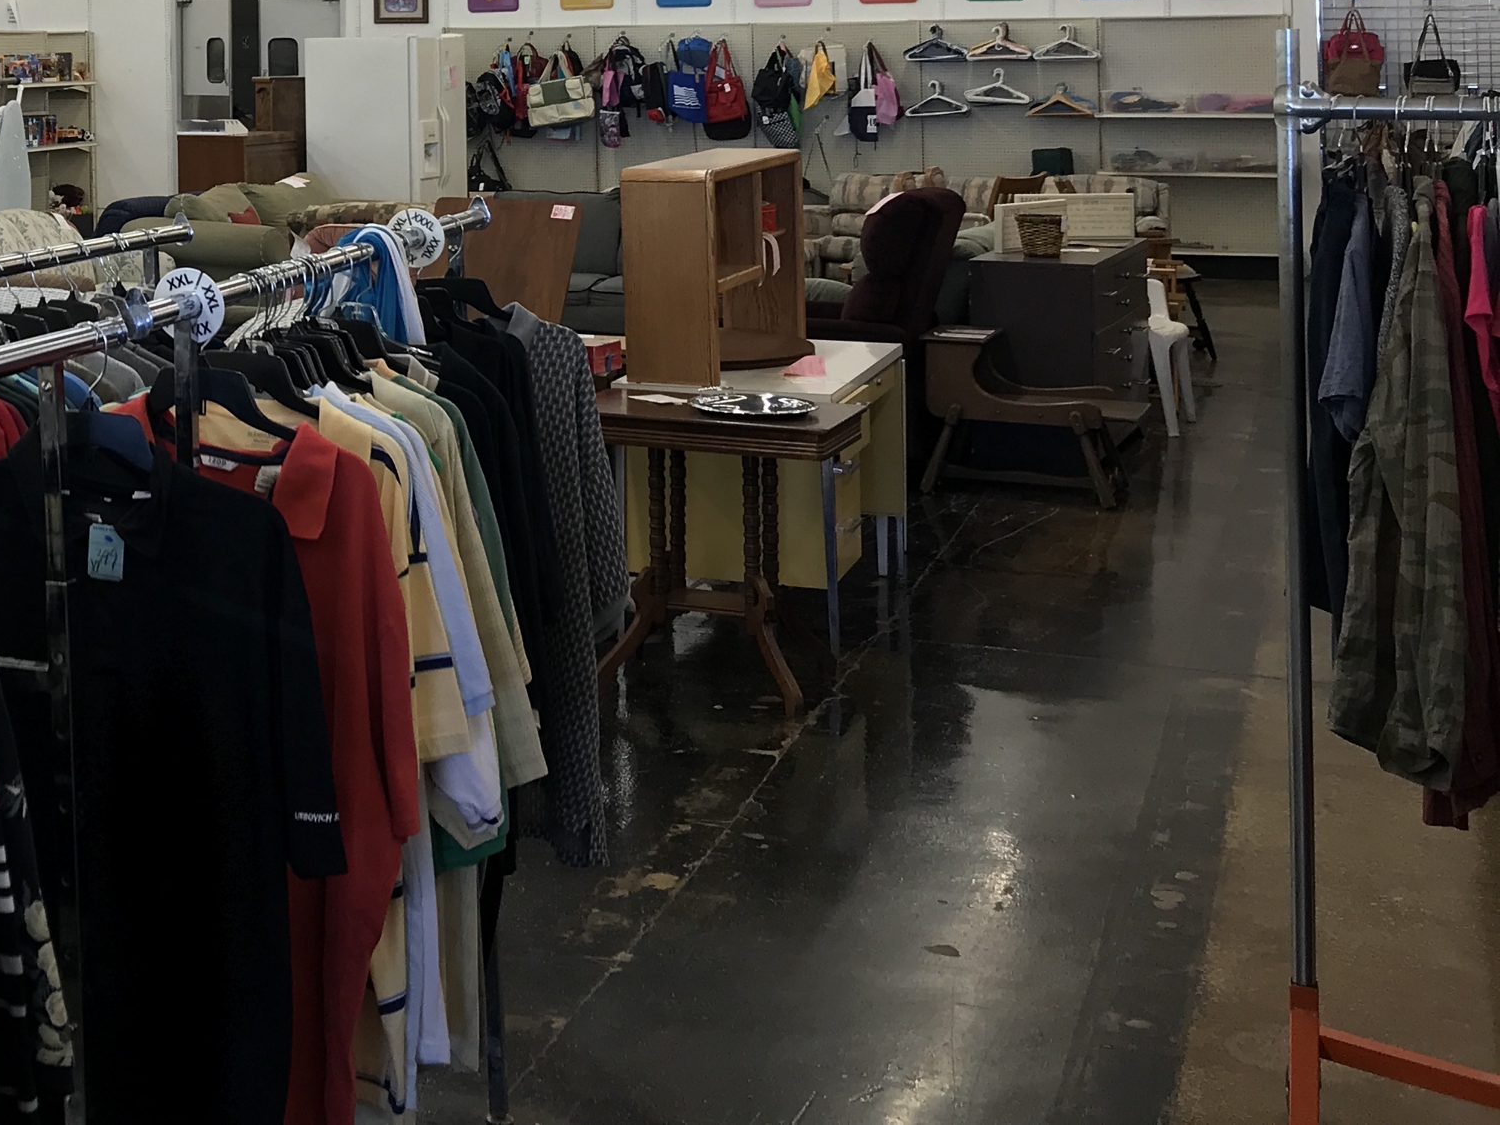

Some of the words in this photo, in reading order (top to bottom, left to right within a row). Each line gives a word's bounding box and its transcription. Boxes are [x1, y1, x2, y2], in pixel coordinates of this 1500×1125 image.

[411, 211, 435, 232] XXXL
[421, 236, 441, 259] XXXL
[166, 273, 194, 291] XXL
[201, 284, 220, 314] XXL
